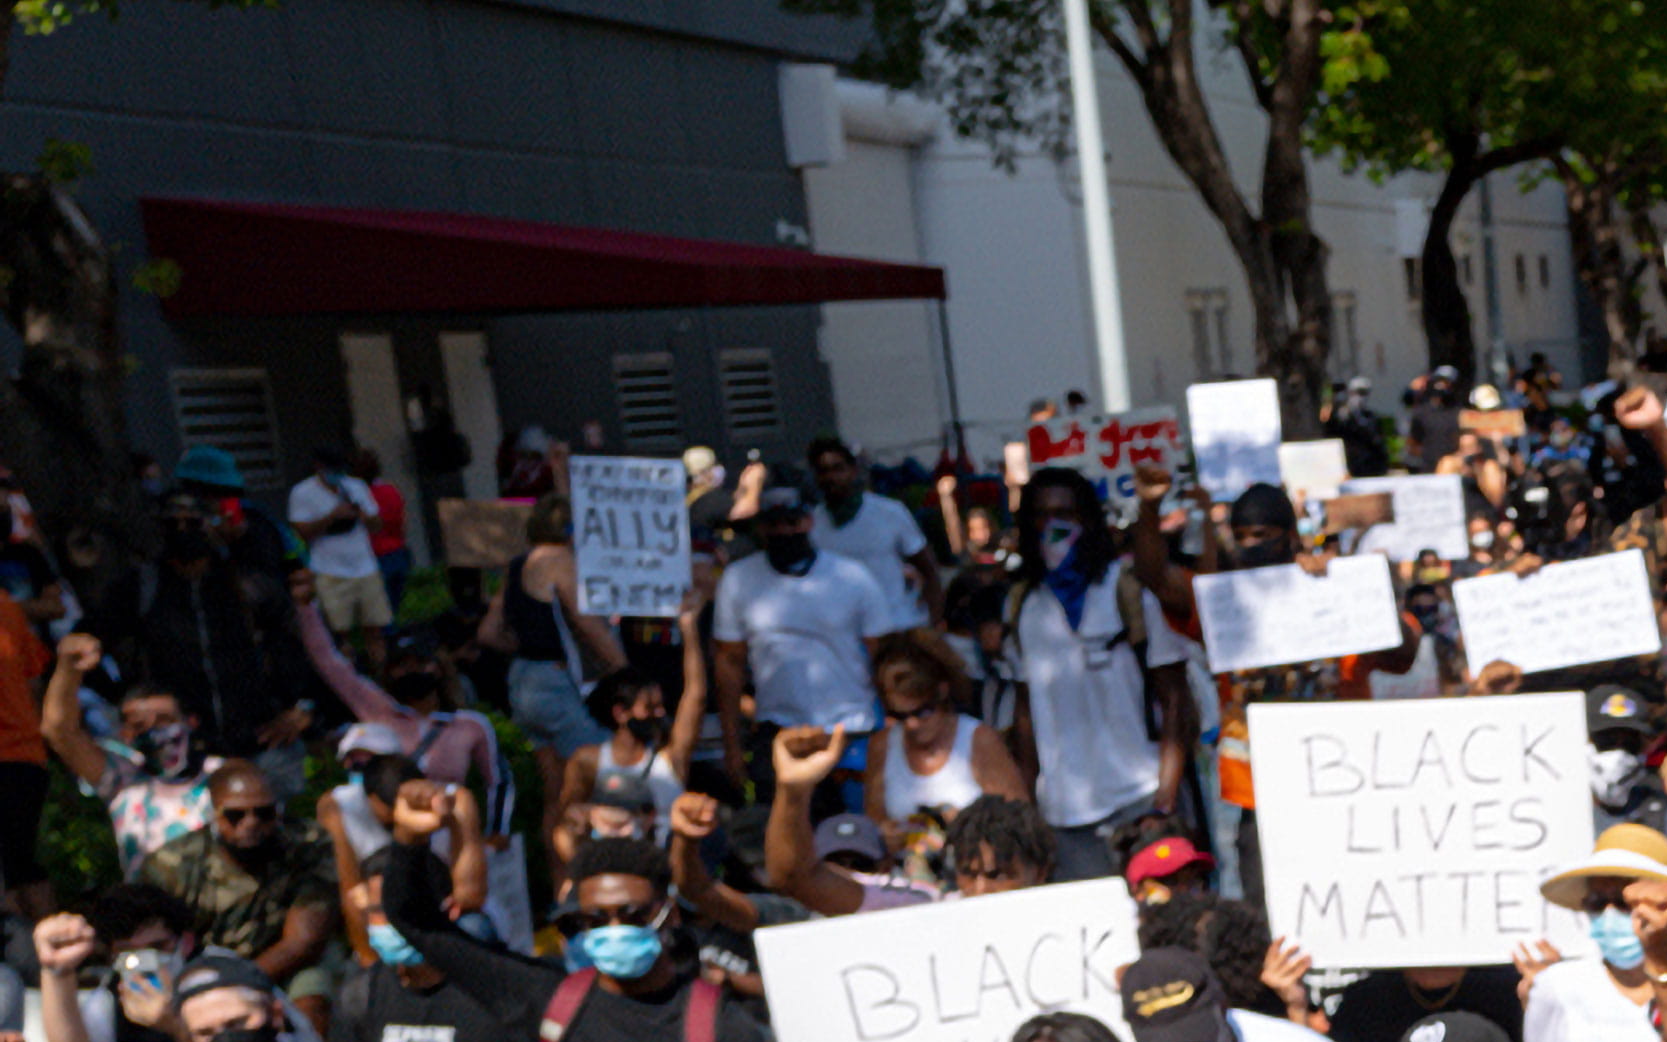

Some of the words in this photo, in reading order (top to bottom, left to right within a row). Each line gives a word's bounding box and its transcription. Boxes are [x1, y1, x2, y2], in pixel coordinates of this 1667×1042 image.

[1302, 723, 1563, 798] BLACK
[1347, 797, 1548, 852] LIVES
[840, 926, 1119, 1042] BLACK
